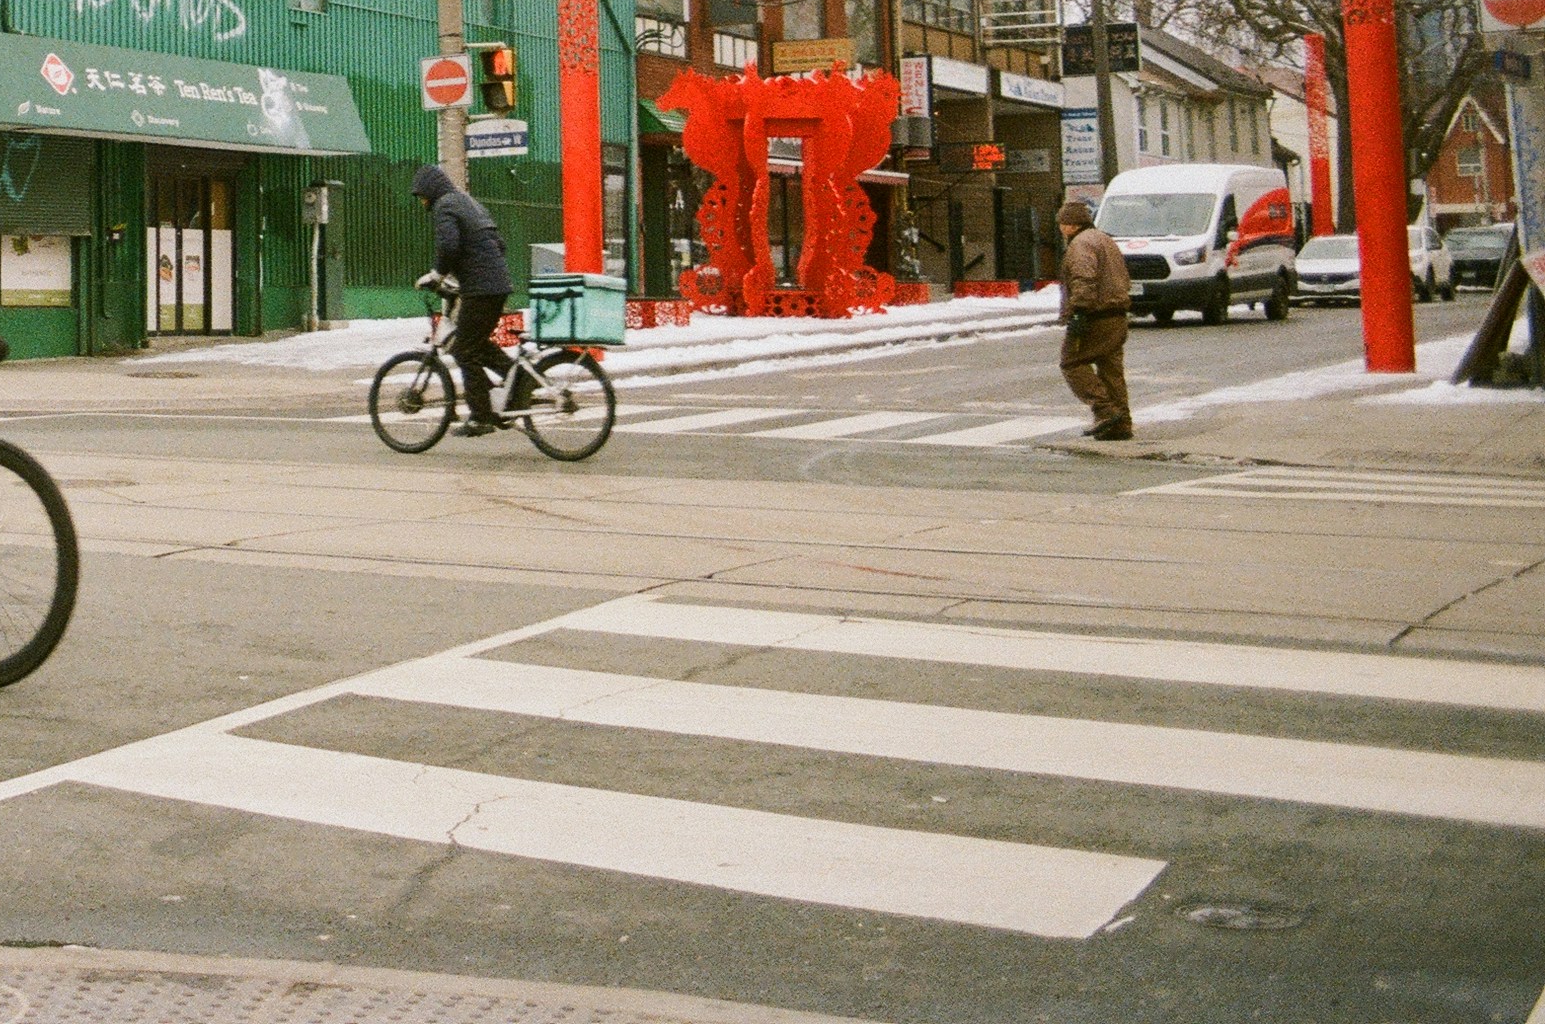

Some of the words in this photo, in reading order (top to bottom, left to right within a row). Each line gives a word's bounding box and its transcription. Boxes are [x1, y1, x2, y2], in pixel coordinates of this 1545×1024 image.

[85, 67, 166, 97] 天仁茗茶
[174, 79, 201, 100] Ten
[202, 82, 236, 104] Ren's
[236, 86, 258, 106] Tea
